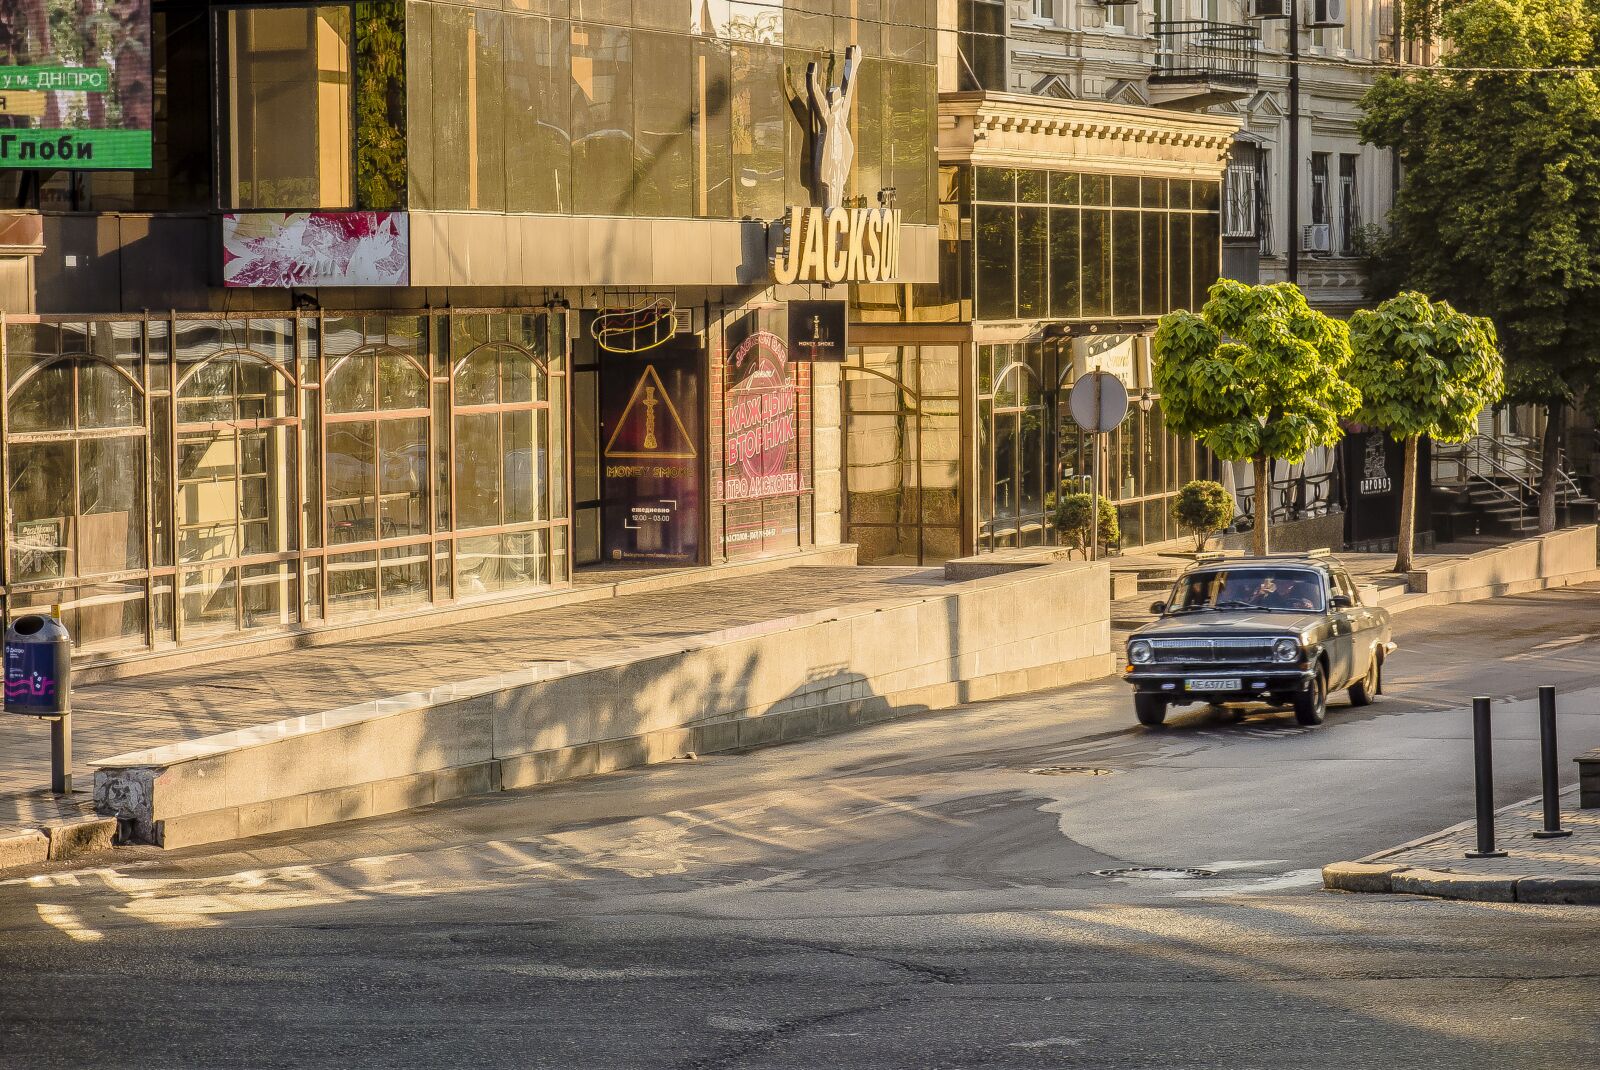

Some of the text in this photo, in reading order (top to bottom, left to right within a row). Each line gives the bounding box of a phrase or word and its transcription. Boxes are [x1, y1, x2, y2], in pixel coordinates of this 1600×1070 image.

[37, 72, 102, 88] ДНІПРО
[1, 135, 93, 160] Глоби
[774, 205, 901, 285] JACKSON
[728, 377, 795, 435] КАЖДЫЙ
[728, 412, 795, 467] ВТОРНИК
[606, 466, 695, 478] MONEY SMOKE
[1360, 477, 1392, 494] ПАРОВОЗ
